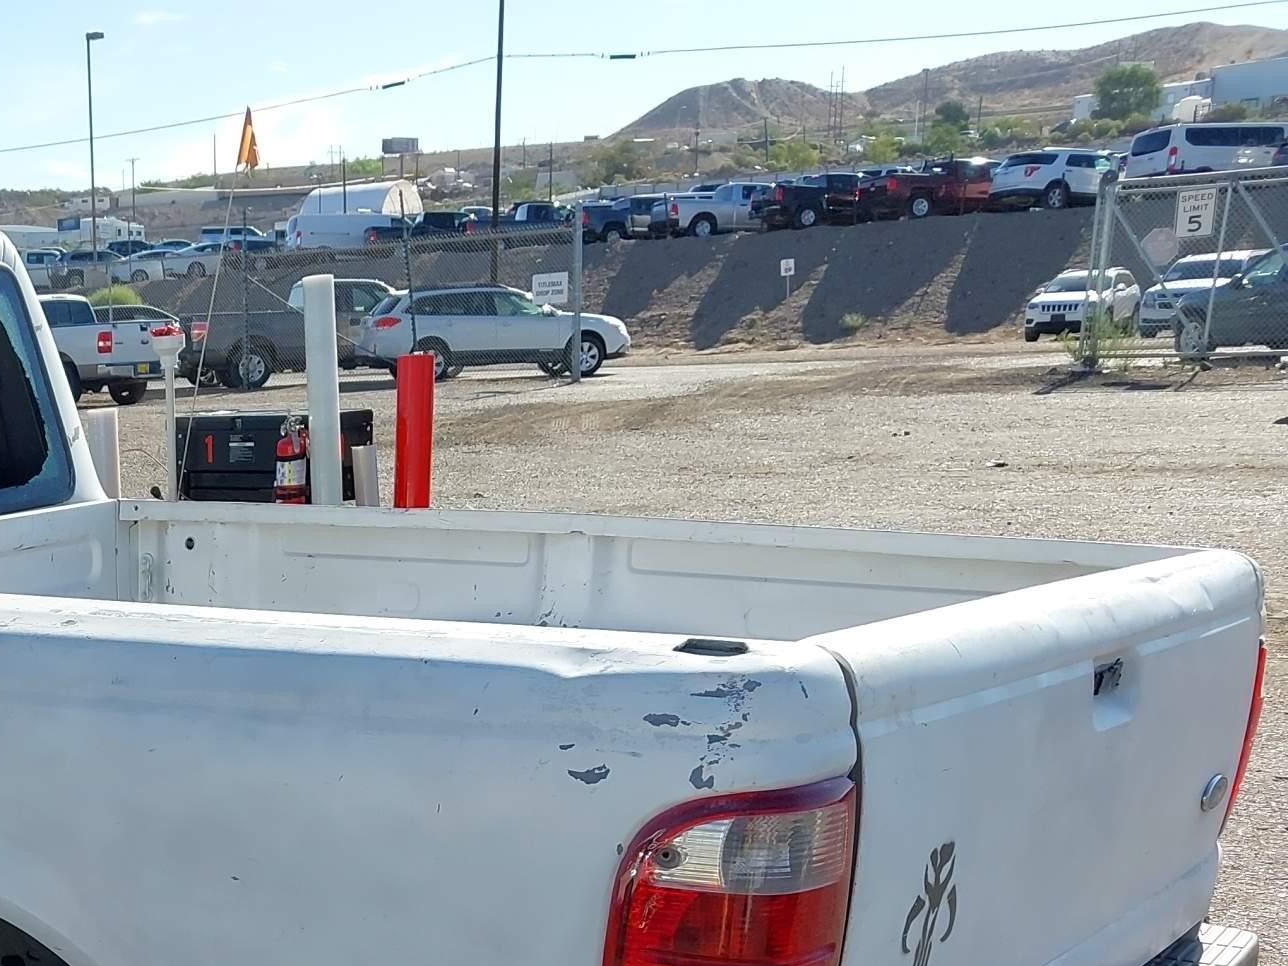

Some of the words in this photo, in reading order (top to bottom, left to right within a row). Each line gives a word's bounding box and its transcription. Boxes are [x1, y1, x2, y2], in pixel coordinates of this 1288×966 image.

[1181, 193, 1214, 203] SPEED
[1183, 203, 1209, 213] LIMIT
[1187, 214, 1202, 232] 5
[204, 434, 214, 464] 1
